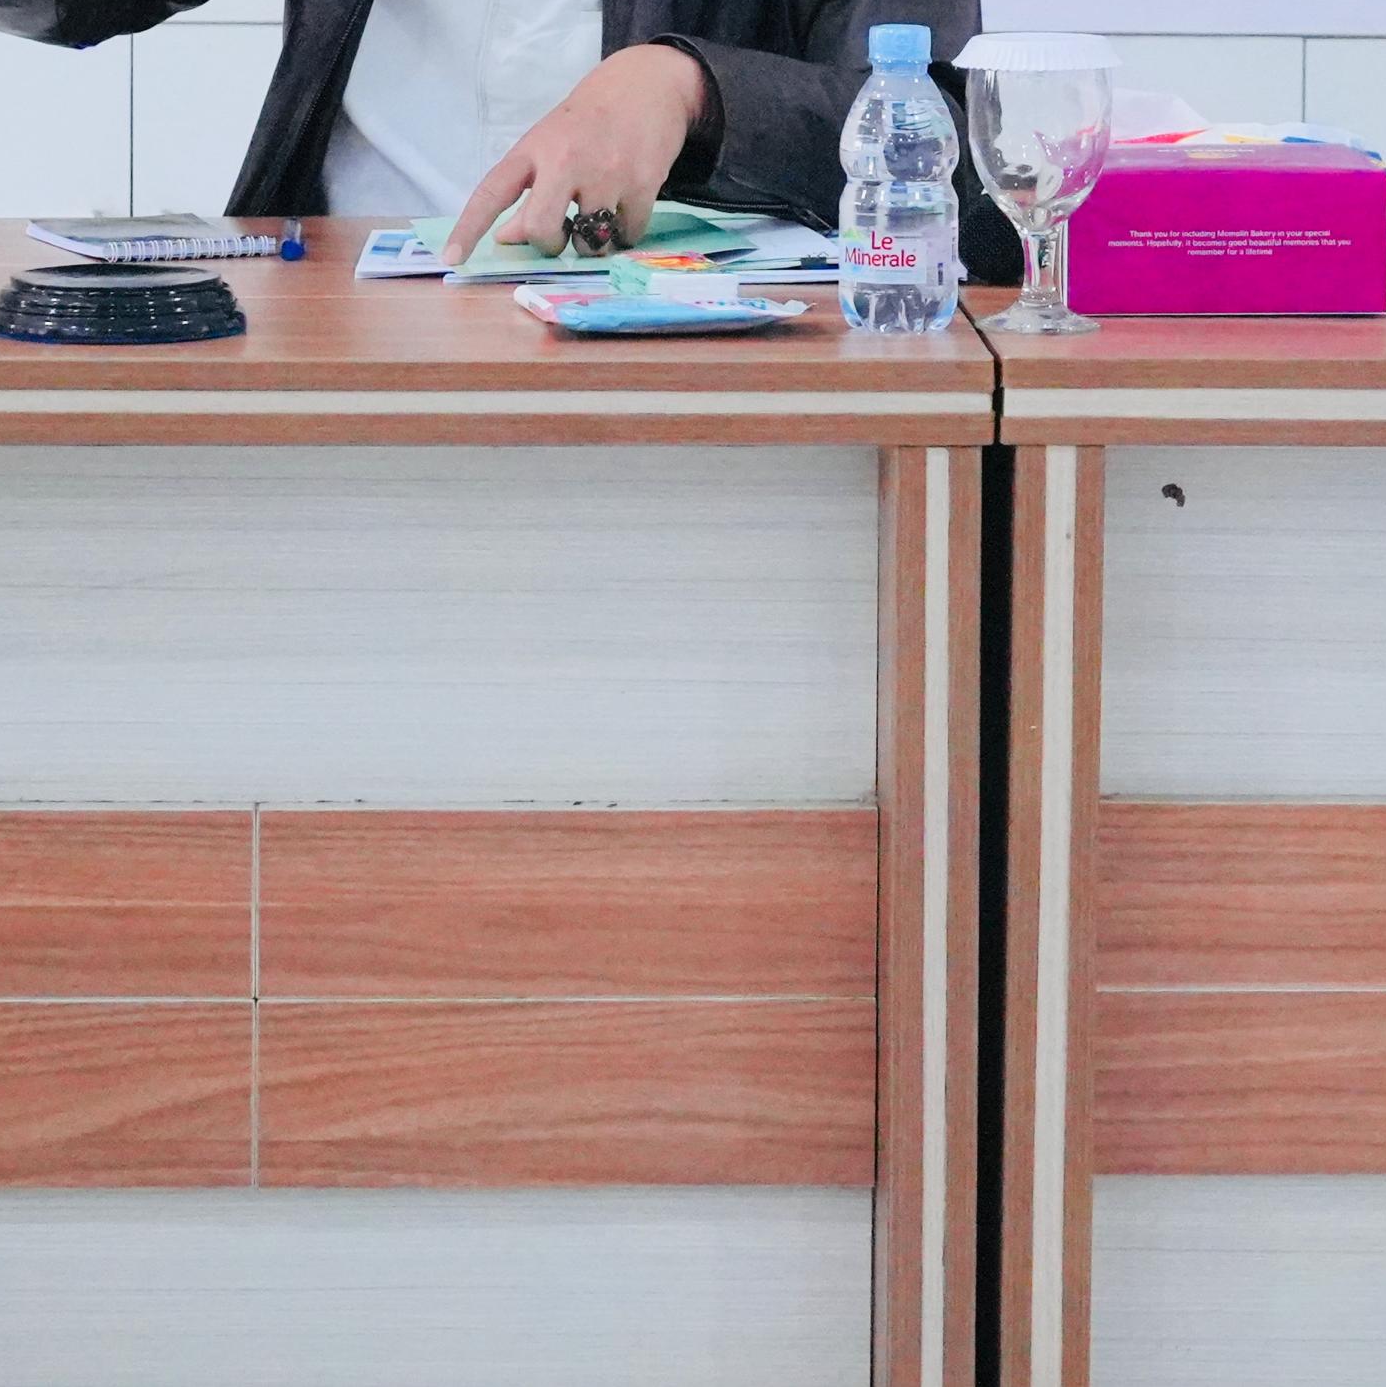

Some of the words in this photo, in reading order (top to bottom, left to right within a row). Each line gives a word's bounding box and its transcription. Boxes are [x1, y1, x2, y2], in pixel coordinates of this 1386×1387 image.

[871, 230, 893, 250] Le
[1129, 230, 1153, 238] Thank
[1153, 231, 1169, 240] you
[1169, 230, 1180, 238] for
[1181, 230, 1216, 239] including
[1250, 230, 1276, 238] Bakery
[1304, 230, 1331, 238] special
[1228, 240, 1248, 248] good
[1249, 239, 1282, 247] beautiful
[844, 246, 916, 268] Minerale
